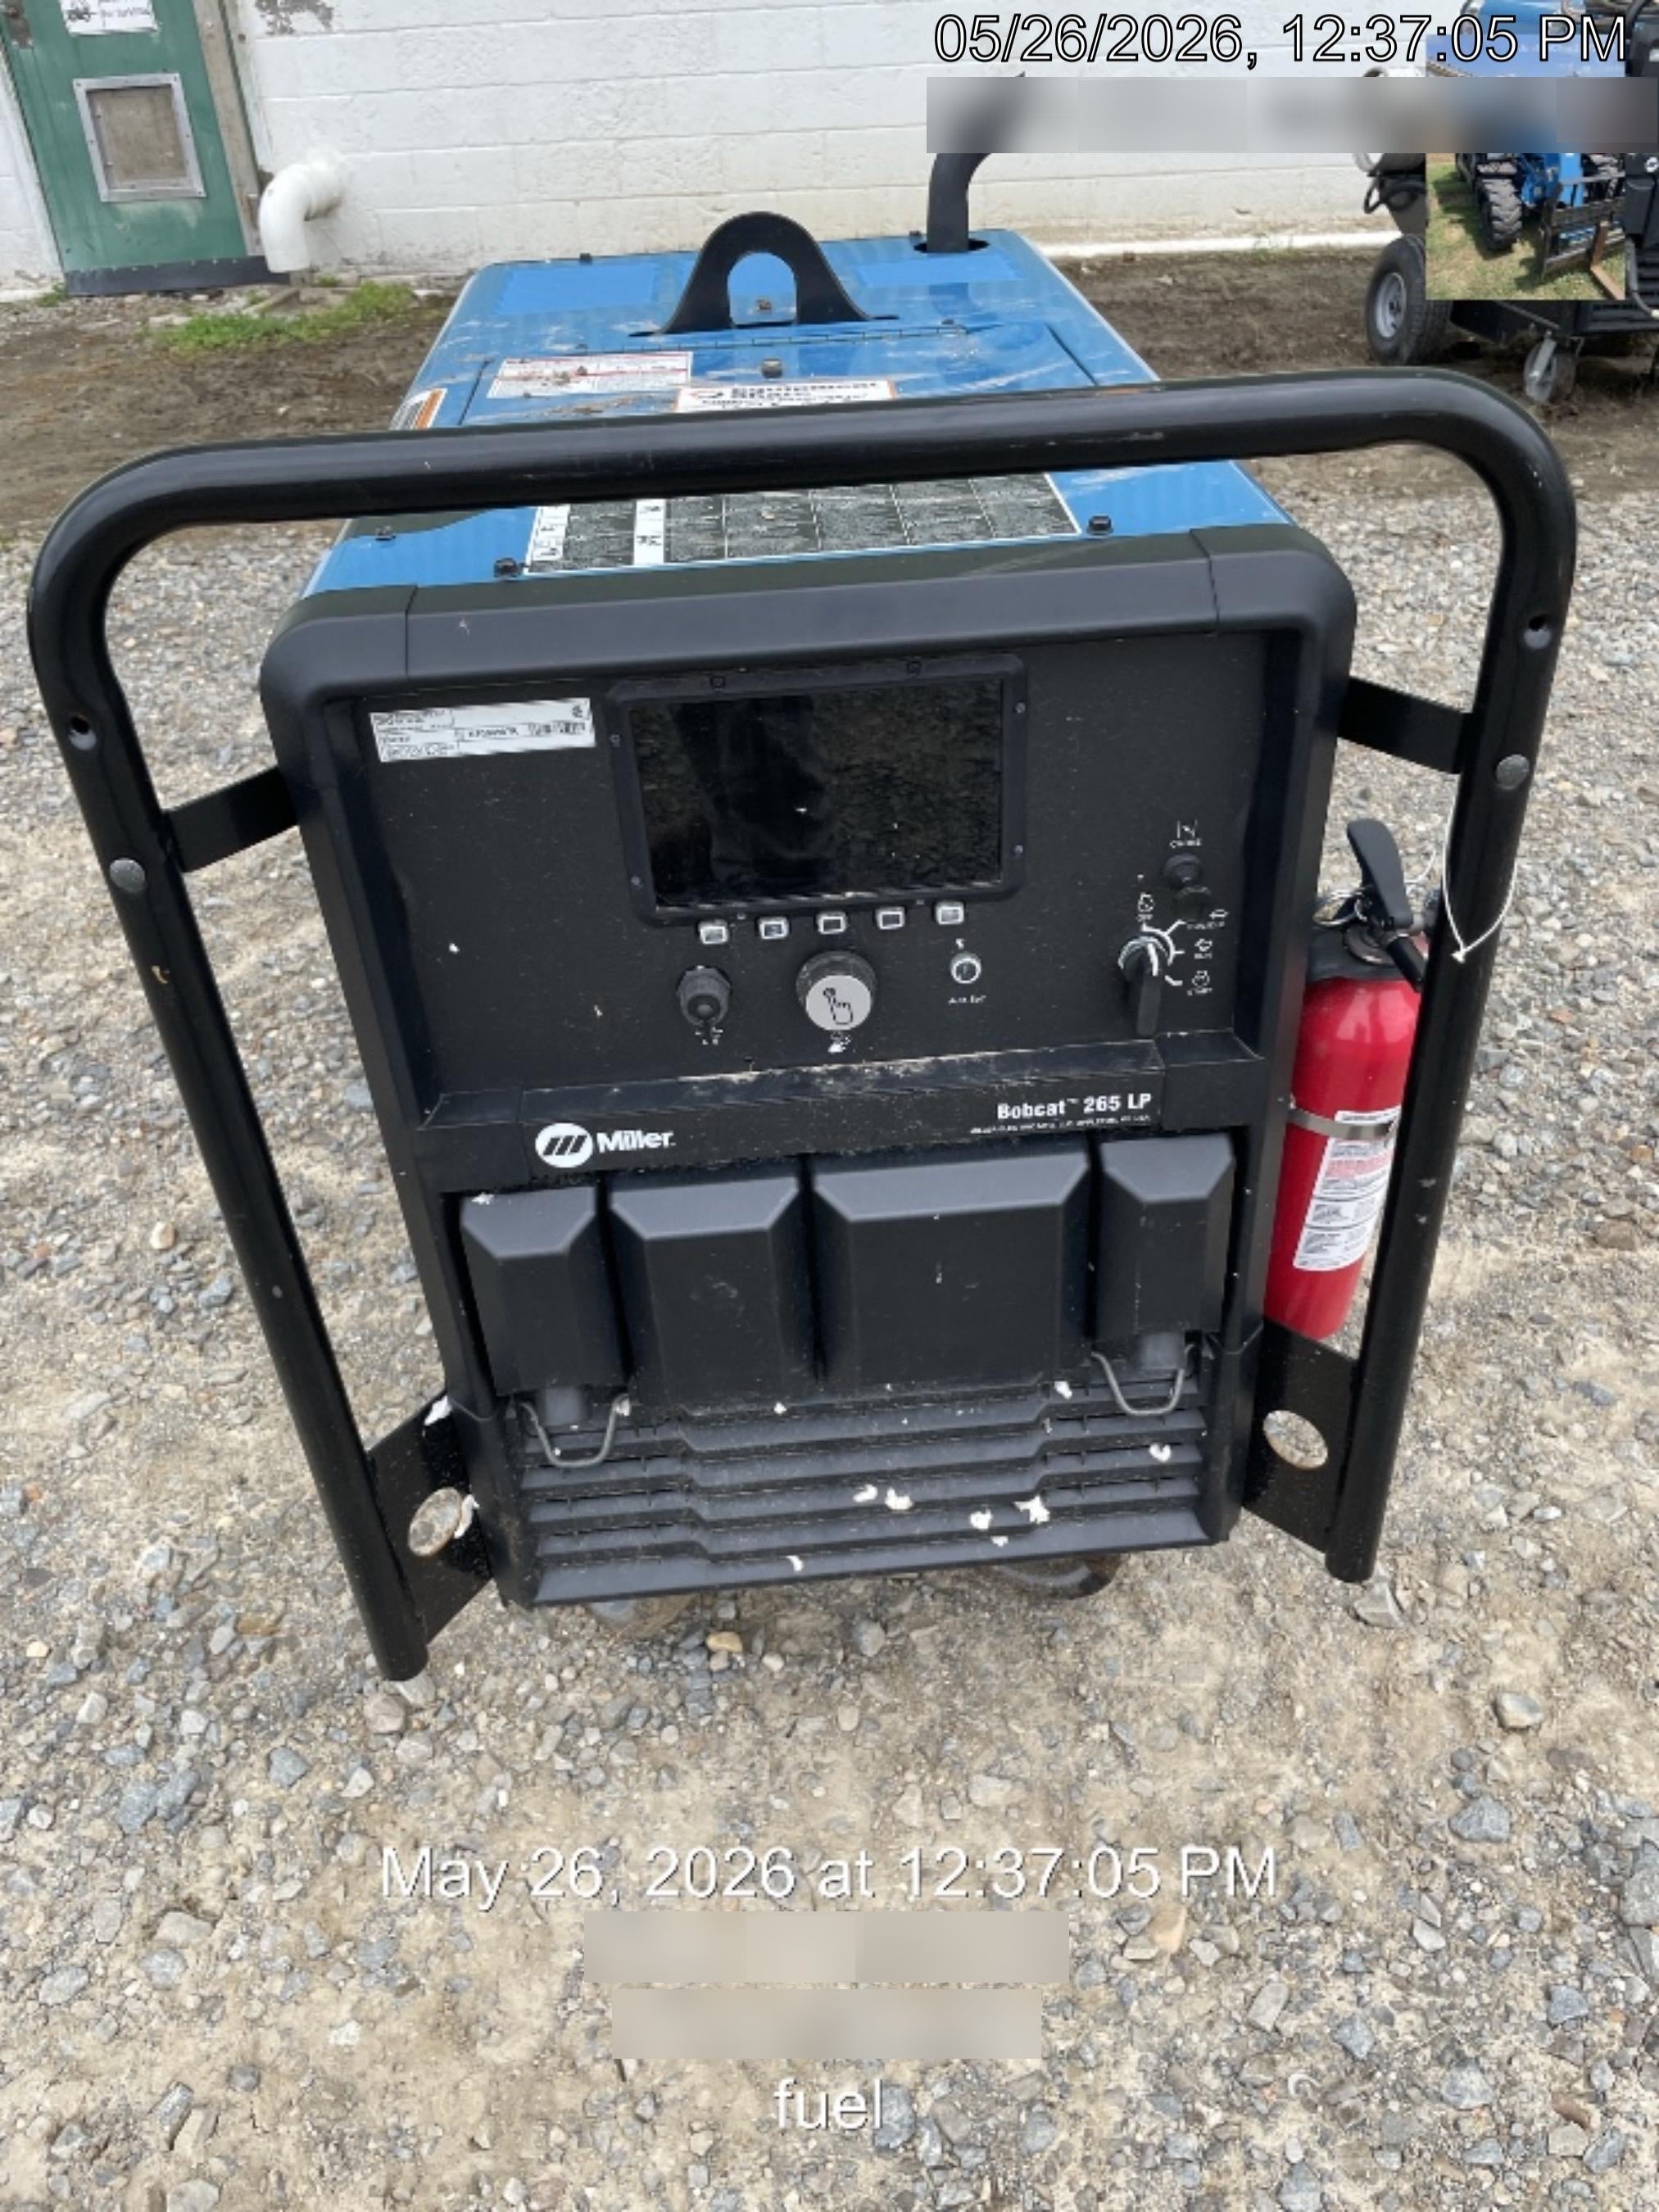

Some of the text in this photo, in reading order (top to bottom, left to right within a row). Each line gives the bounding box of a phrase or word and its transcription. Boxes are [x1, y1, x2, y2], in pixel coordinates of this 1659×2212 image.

[1083, 1095, 1122, 1114] 265
[1127, 1093, 1152, 1109] LP
[596, 1129, 674, 1154] Miller
